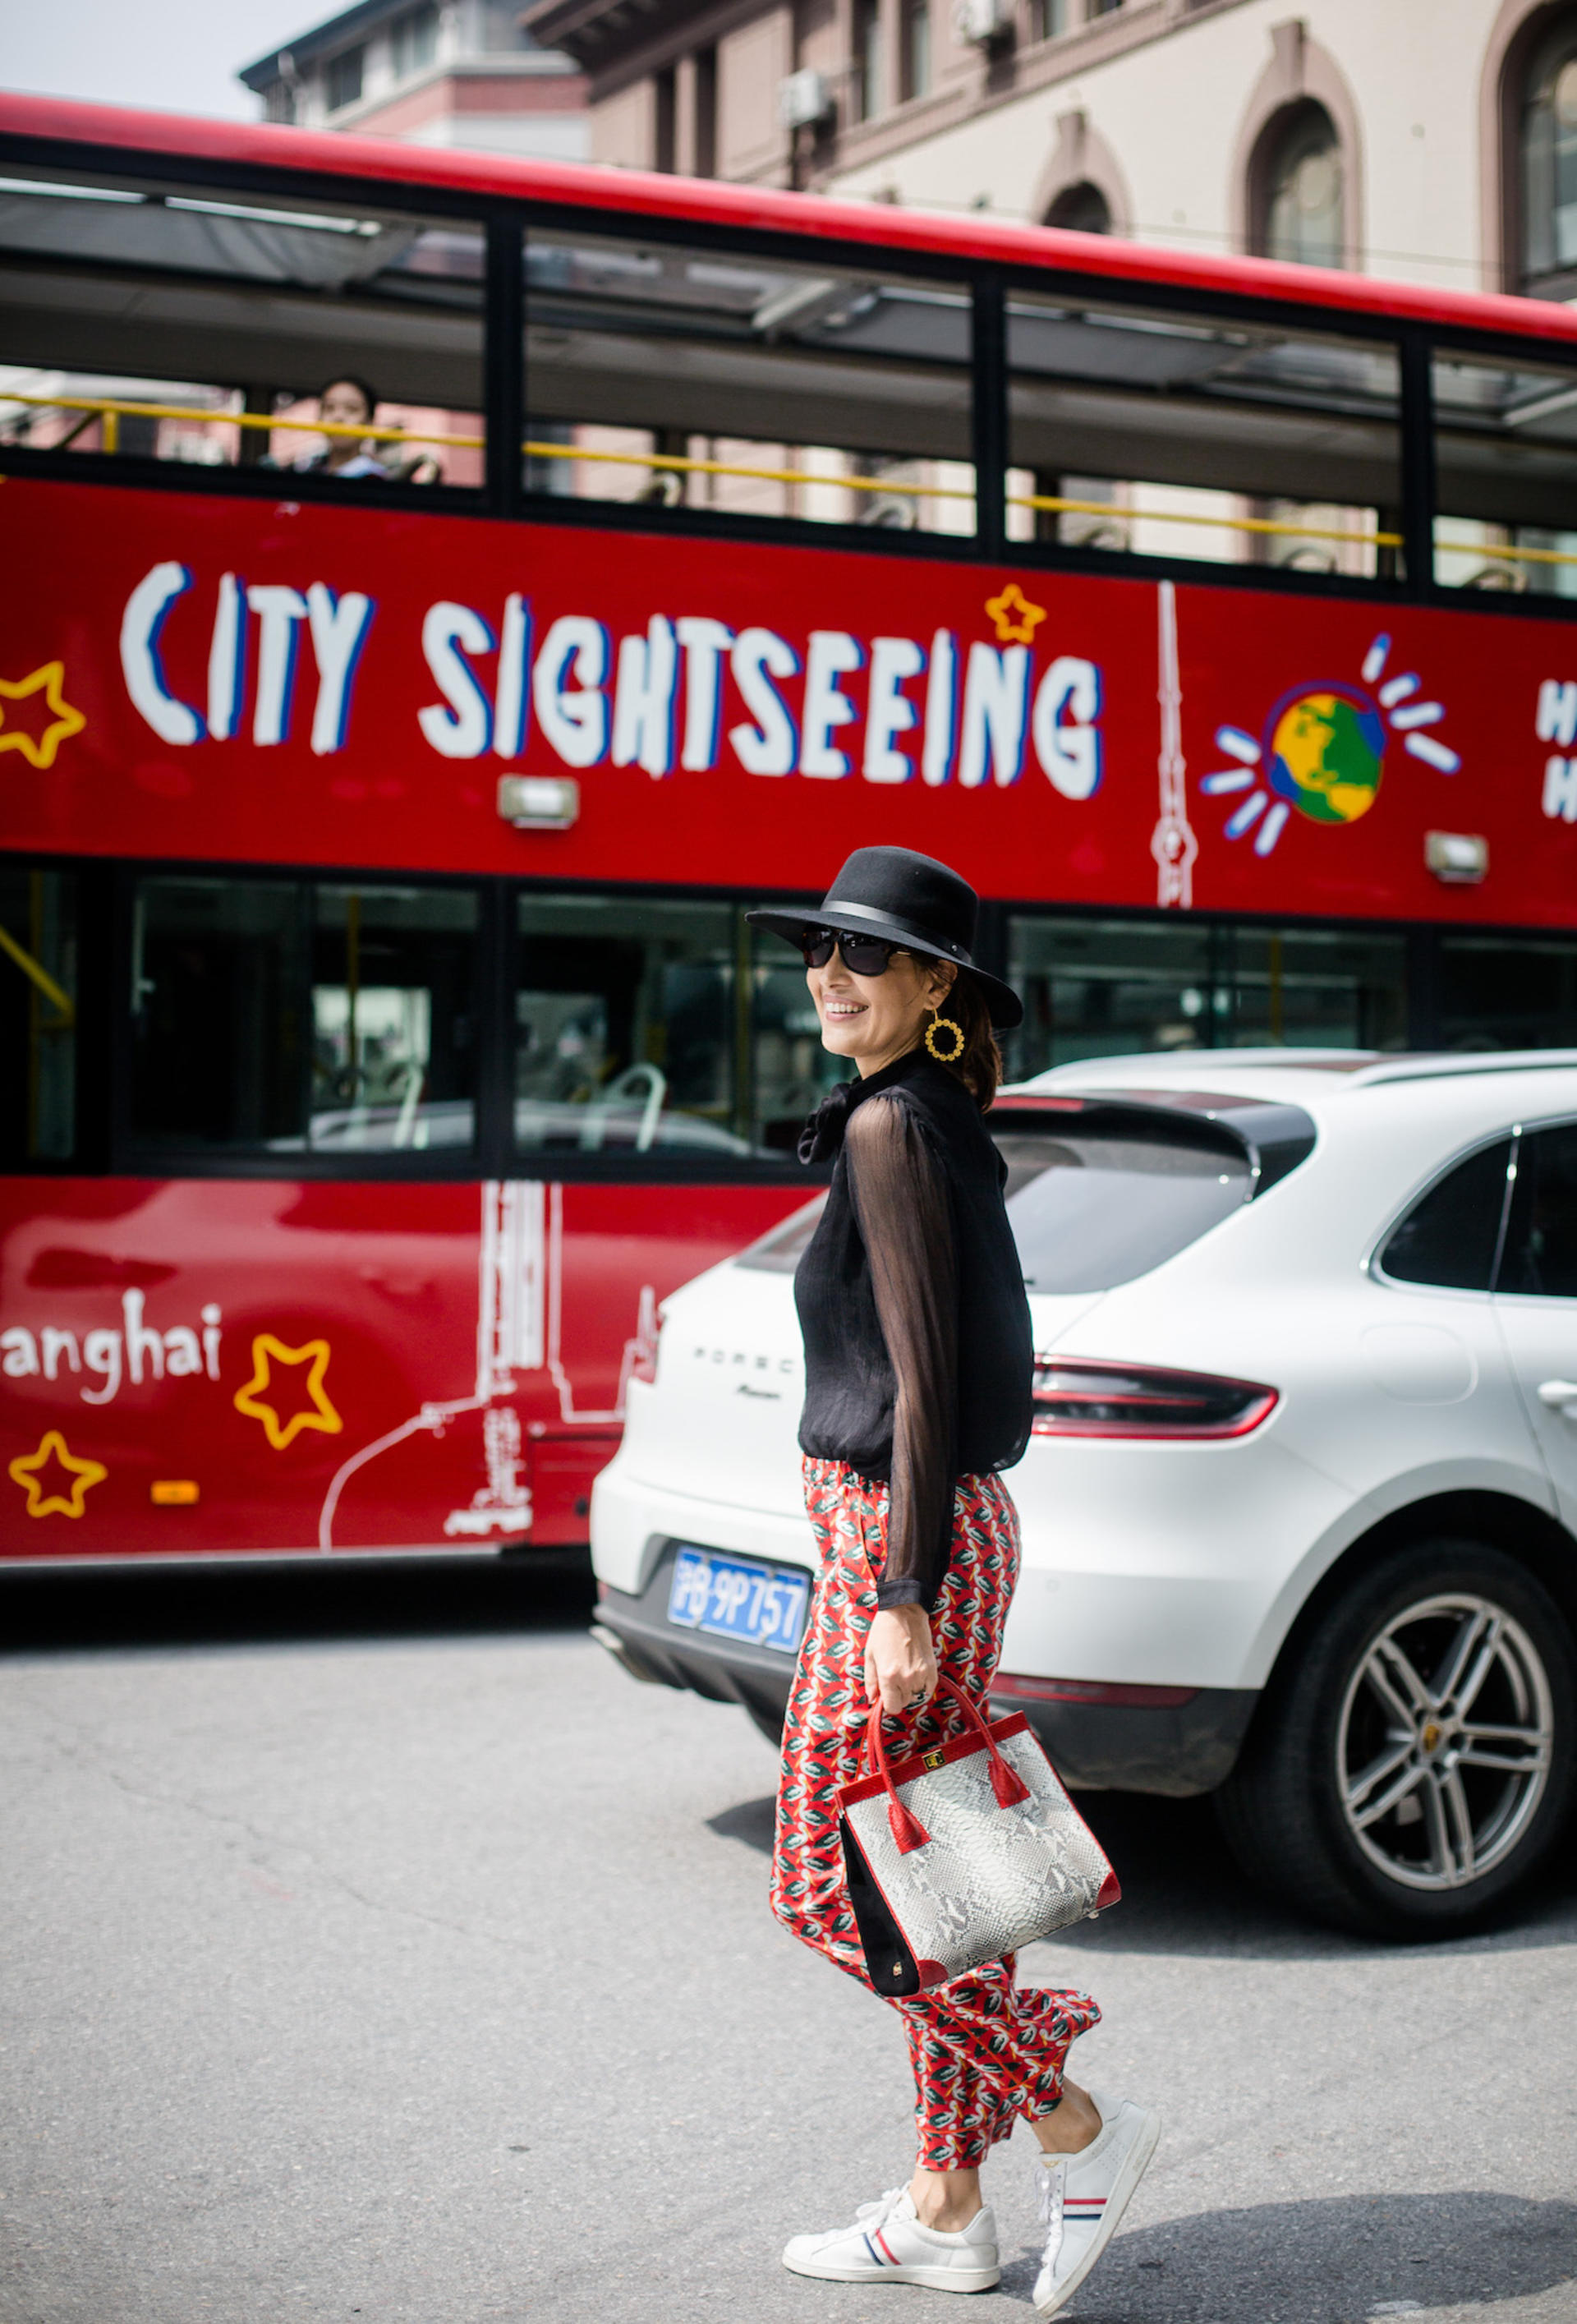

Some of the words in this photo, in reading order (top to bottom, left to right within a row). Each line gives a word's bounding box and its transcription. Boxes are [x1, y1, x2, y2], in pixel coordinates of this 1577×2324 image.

[119, 560, 375, 755] CITY
[418, 592, 1101, 800] SIGHTSEEING
[0, 1287, 222, 1405] anghai
